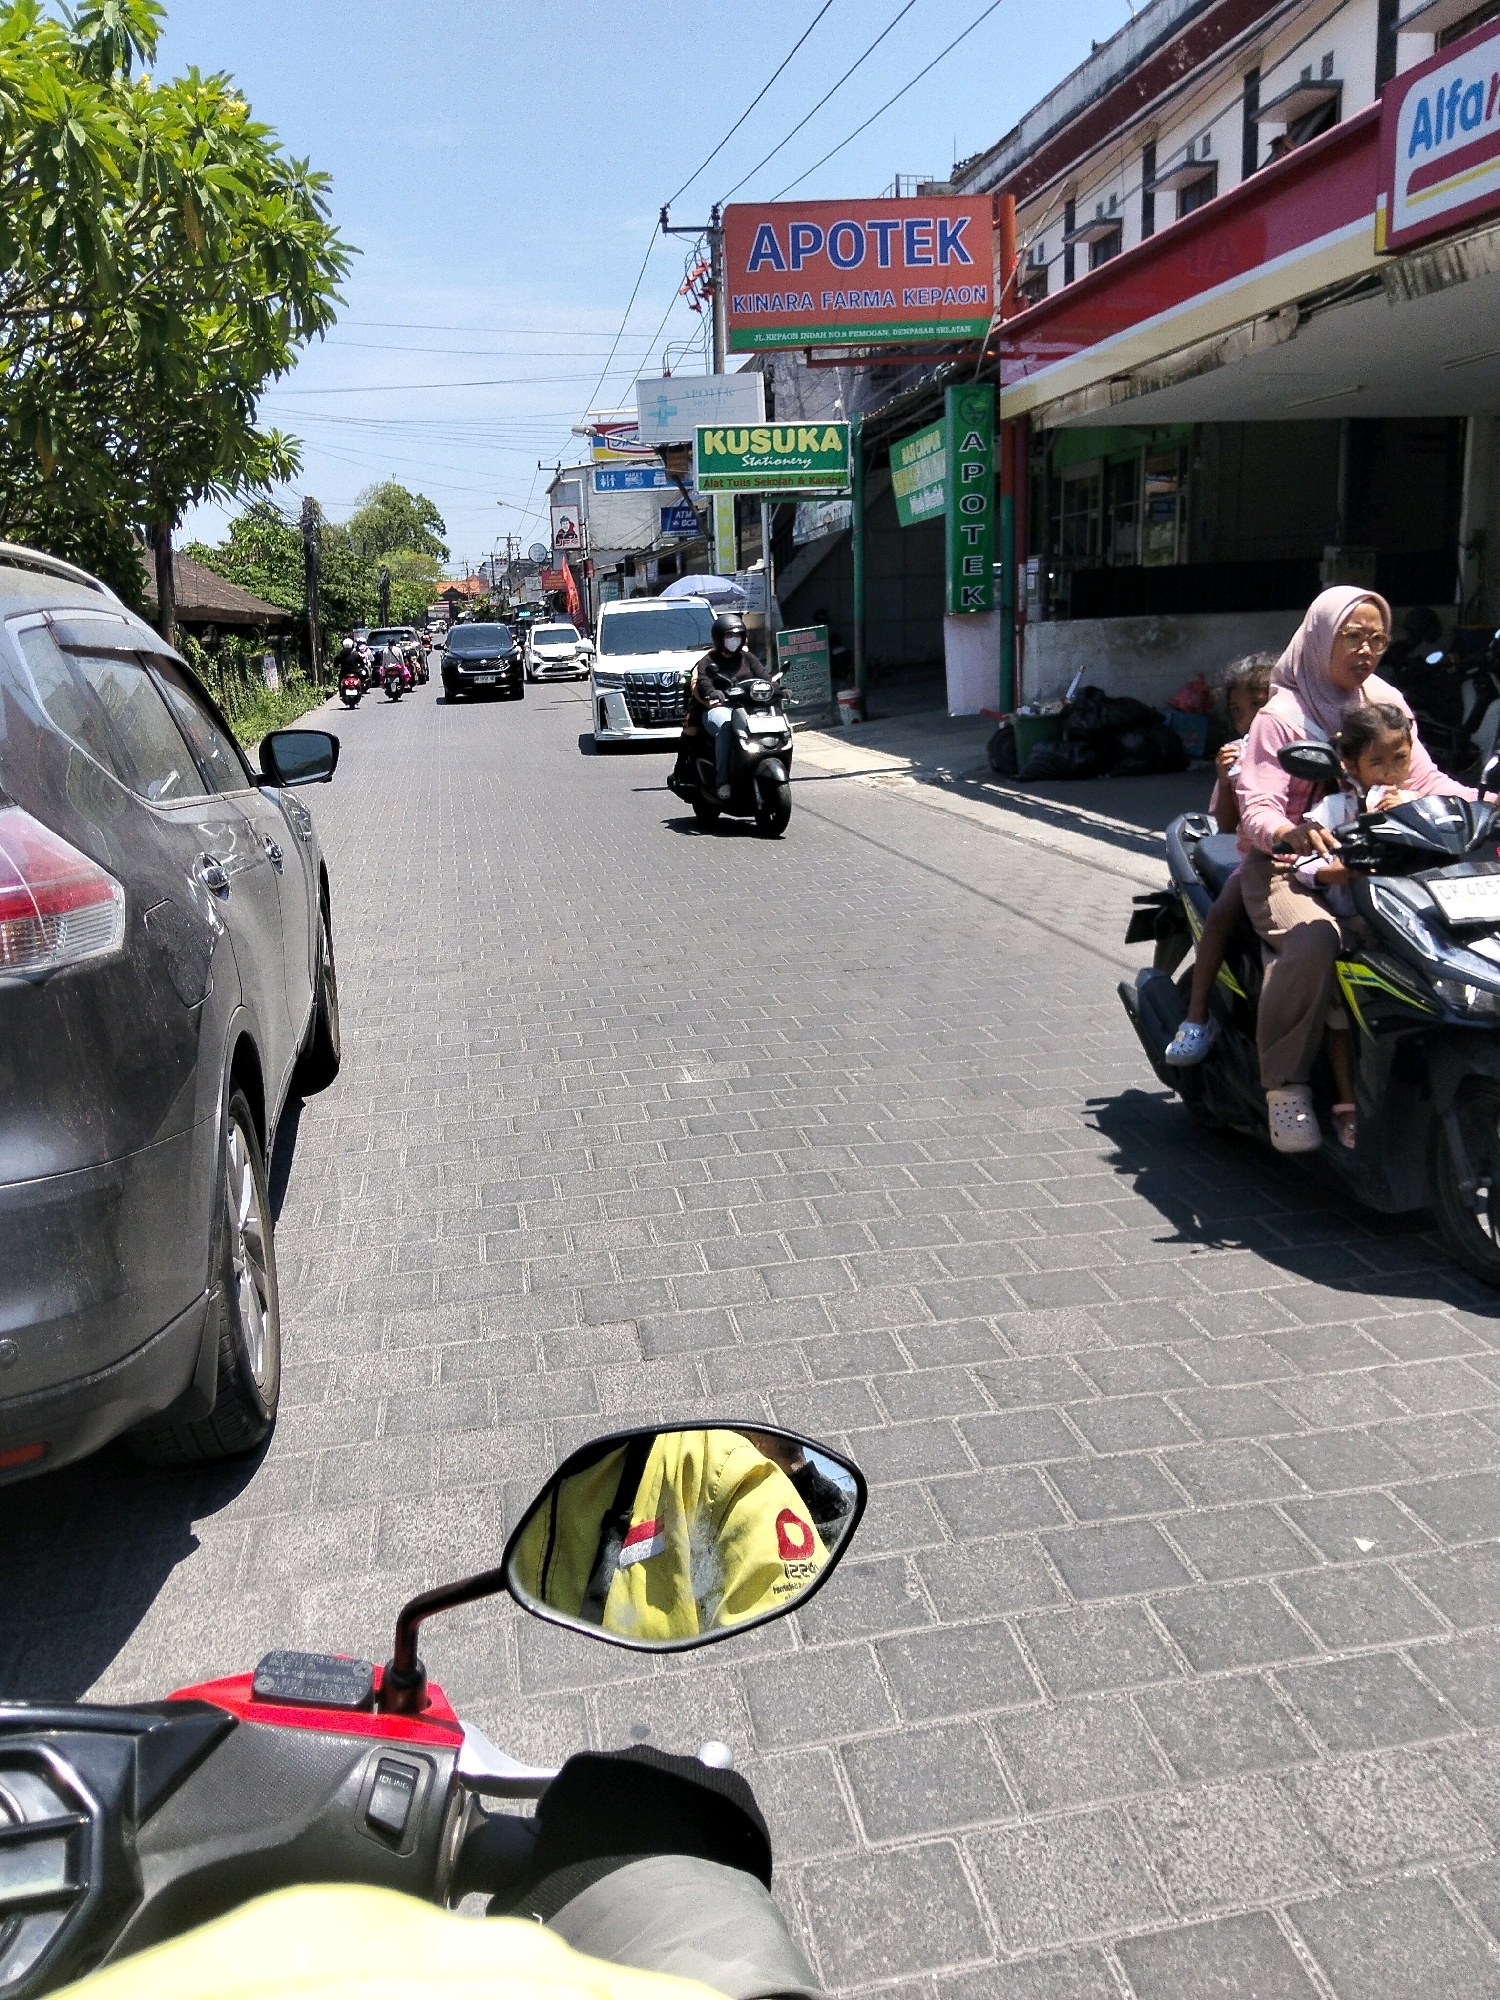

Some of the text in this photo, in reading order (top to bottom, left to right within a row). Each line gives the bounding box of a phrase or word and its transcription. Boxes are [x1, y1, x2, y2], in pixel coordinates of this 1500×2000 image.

[747, 216, 974, 272] APOTEK
[732, 285, 987, 314] KINARA FARMA KEPAON
[800, 331, 827, 340] INDAH
[892, 327, 935, 336] DENPASAR
[936, 325, 972, 334] SELATAN
[704, 427, 842, 455] KUSUKA
[741, 454, 812, 469] Stationery
[703, 475, 843, 488] Alat Tulis Sekolah & Kantor
[675, 510, 693, 519] ATM
[959, 431, 986, 605] APOTEK
[681, 518, 697, 527] BCA
[378, 1773, 409, 1789] IDLING
